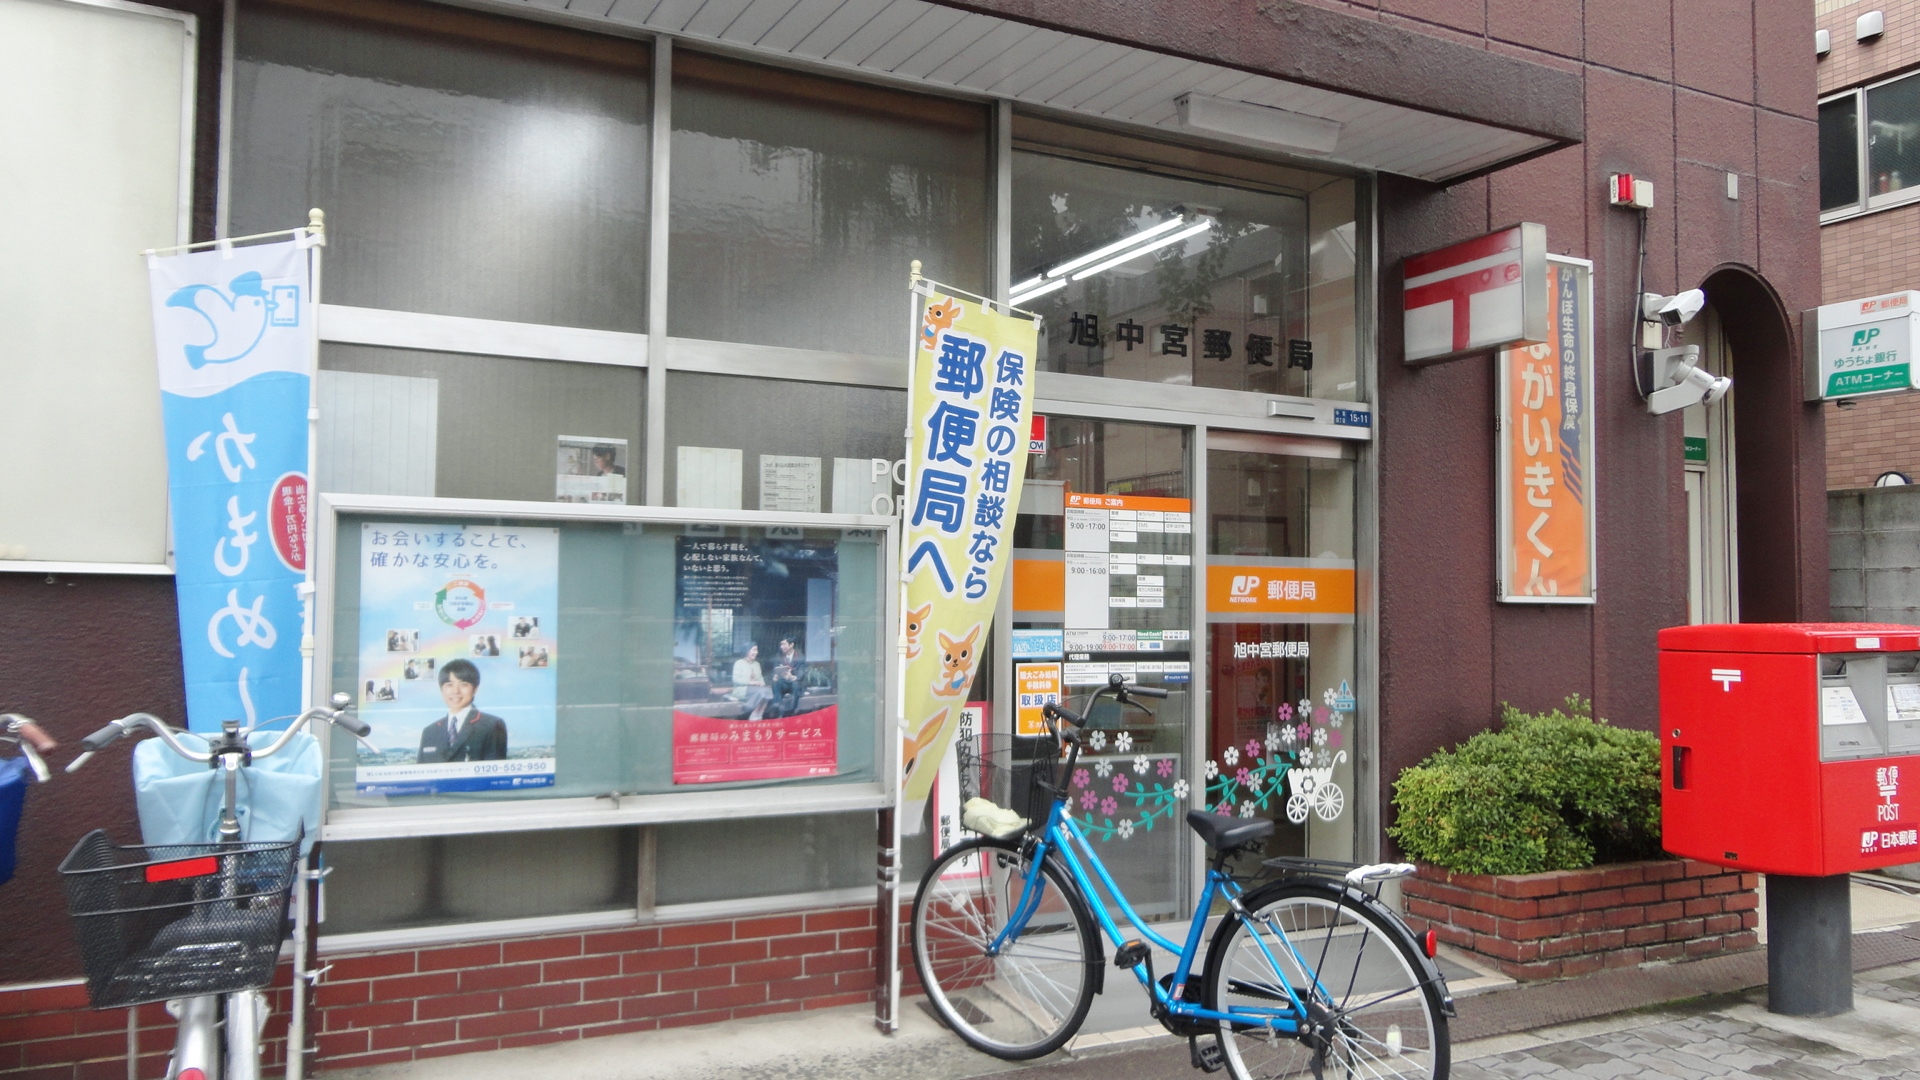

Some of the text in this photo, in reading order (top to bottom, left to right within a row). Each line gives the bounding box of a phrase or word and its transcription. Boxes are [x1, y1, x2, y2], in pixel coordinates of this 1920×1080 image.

[1069, 312, 1313, 370] 旭中宮郵便局
[1852, 328, 1880, 346] JP
[1851, 344, 1877, 352] BANK
[1834, 350, 1897, 368] ゆうちょ銀行
[1836, 371, 1903, 386] ATMコーナー
[1350, 414, 1367, 423] 15-11
[871, 458, 906, 486] PO
[908, 334, 986, 594] 郵便局へ
[965, 350, 1024, 599] 保険の相談なら
[1105, 498, 1123, 506] ご案内
[372, 530, 528, 549] お会いすることで、
[684, 542, 748, 551] 一人で暮らす親を、
[370, 552, 498, 570] 確かな安心を。
[683, 553, 763, 562] 心配しない家族なんて、
[684, 564, 730, 573] いないと思う。
[1231, 576, 1260, 595] JP
[1267, 580, 1316, 600] 郵便局
[1234, 642, 1309, 658] 旭中宮郵便局
[690, 728, 822, 742] 郵便局のみまもりサービス
[474, 762, 546, 774] 0120-552-950
[1876, 766, 1898, 786] 郵便
[1878, 804, 1900, 821] POST
[1862, 831, 1878, 848] JP
[1881, 830, 1918, 848] 日本郵便
